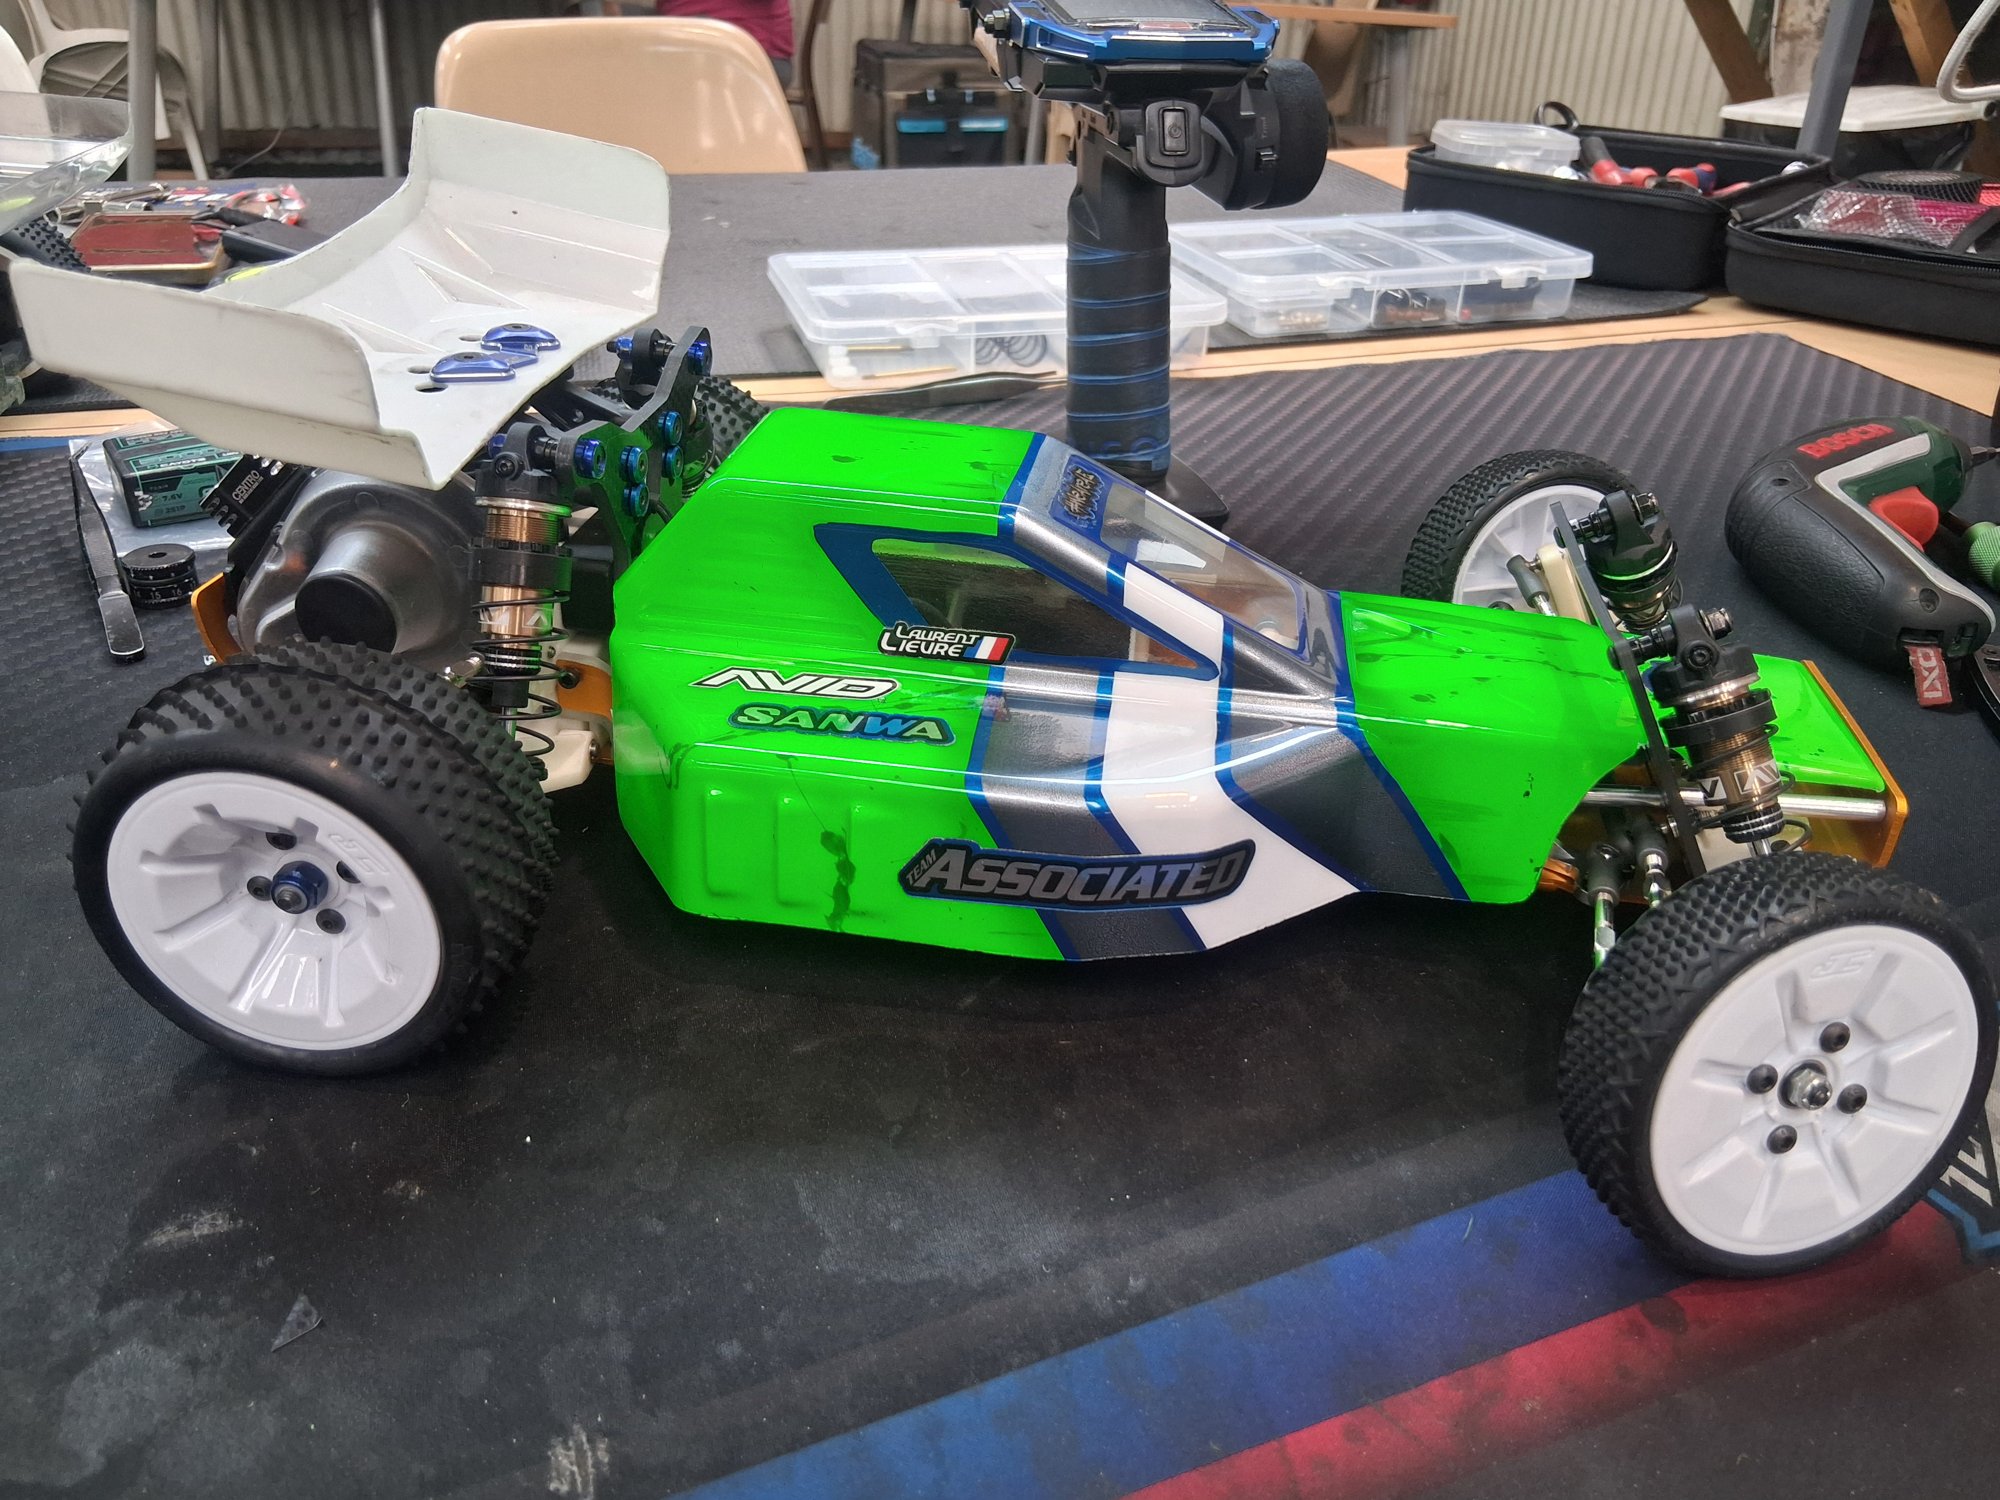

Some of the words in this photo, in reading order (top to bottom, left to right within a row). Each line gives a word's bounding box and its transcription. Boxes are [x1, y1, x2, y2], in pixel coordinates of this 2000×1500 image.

[231, 470, 260, 501] CENTRO
[896, 625, 980, 645] LAURENT
[736, 706, 943, 740] SANWA
[905, 849, 938, 886] TEAM
[913, 848, 1244, 902] ASSOCIATED
